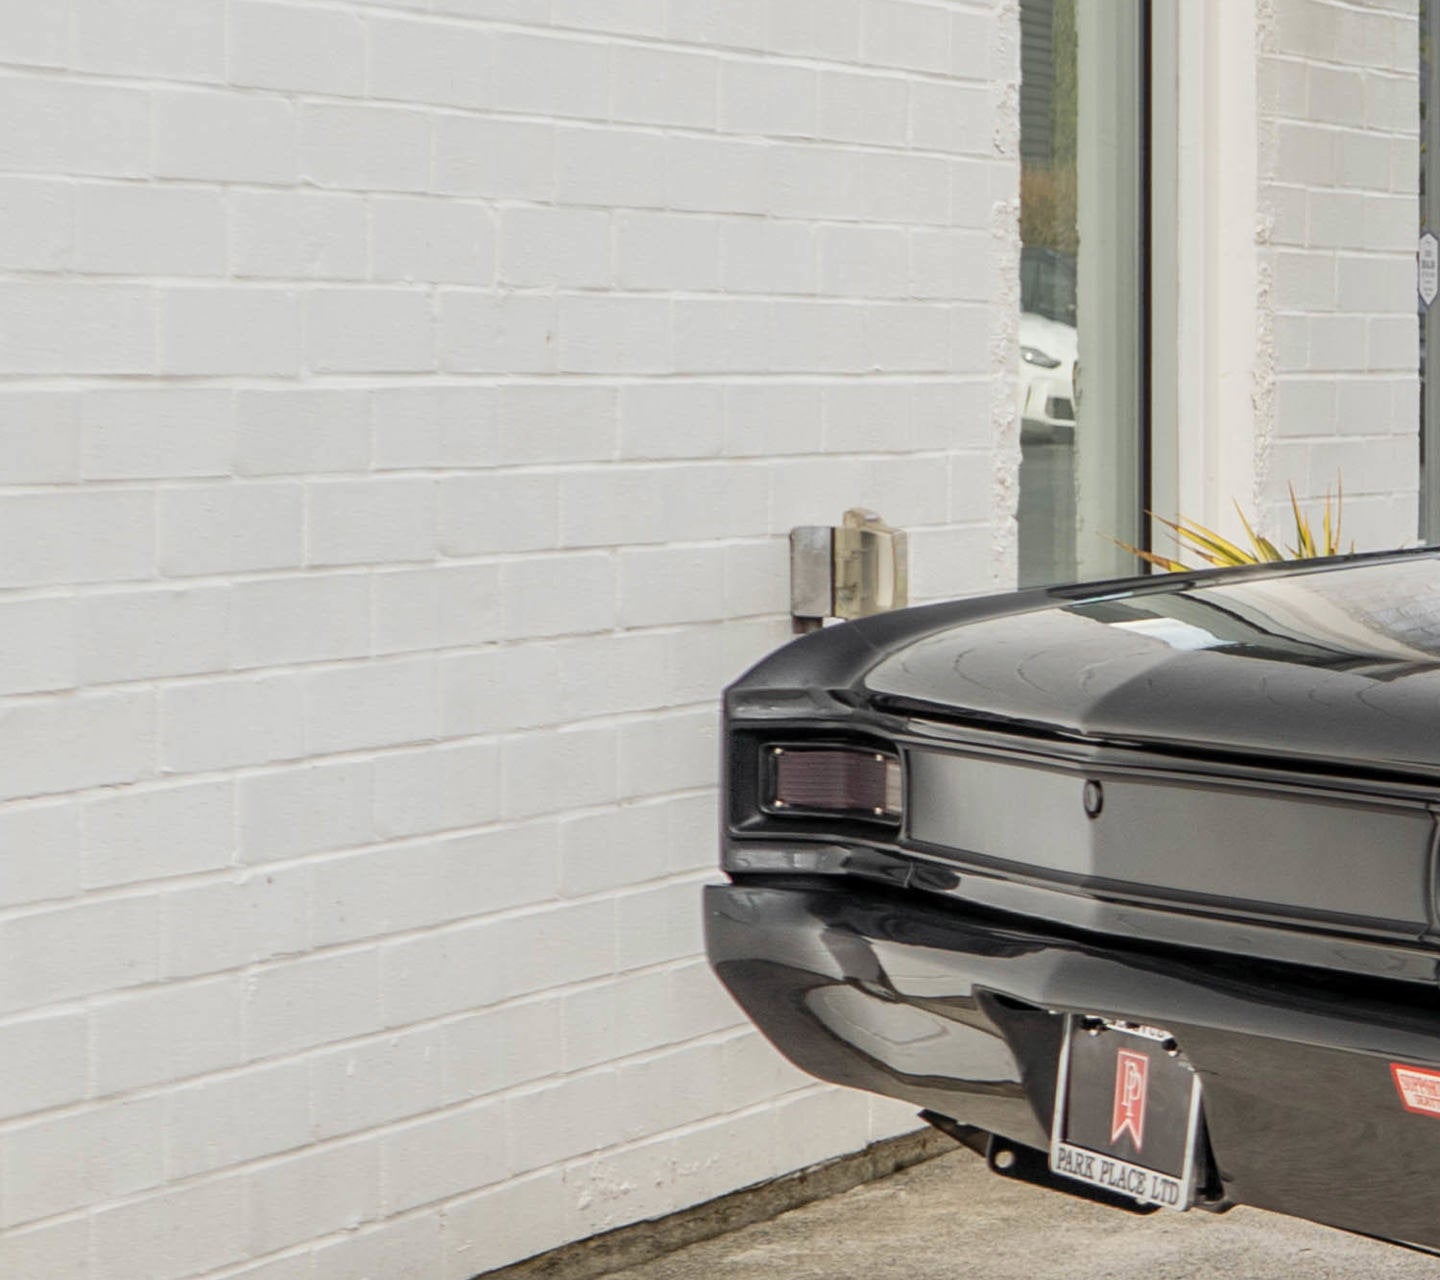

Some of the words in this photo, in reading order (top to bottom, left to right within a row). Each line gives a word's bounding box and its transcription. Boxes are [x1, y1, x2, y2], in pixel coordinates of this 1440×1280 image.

[1056, 1147, 1095, 1179] PARK
[1099, 1159, 1147, 1195] PLACE
[1150, 1176, 1180, 1206] LTD
